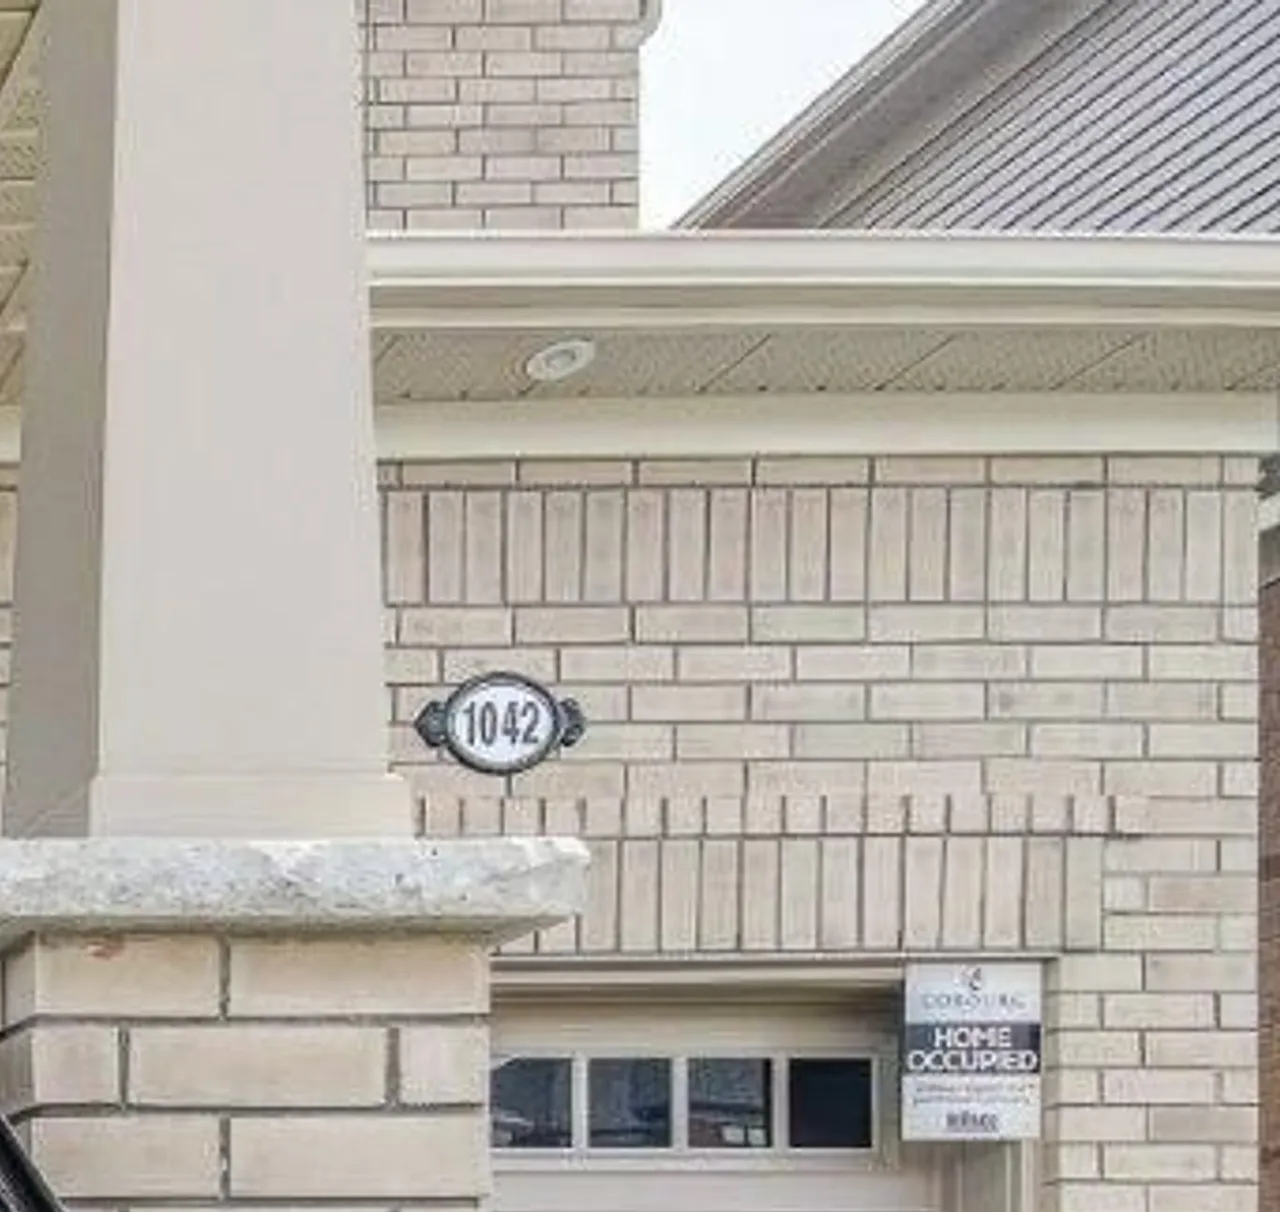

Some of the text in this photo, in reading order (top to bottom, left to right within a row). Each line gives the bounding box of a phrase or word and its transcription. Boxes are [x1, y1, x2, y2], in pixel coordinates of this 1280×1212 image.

[463, 700, 540, 747] 1042
[933, 1026, 1013, 1048] HOME
[906, 1049, 1039, 1071] OCCUPIED
